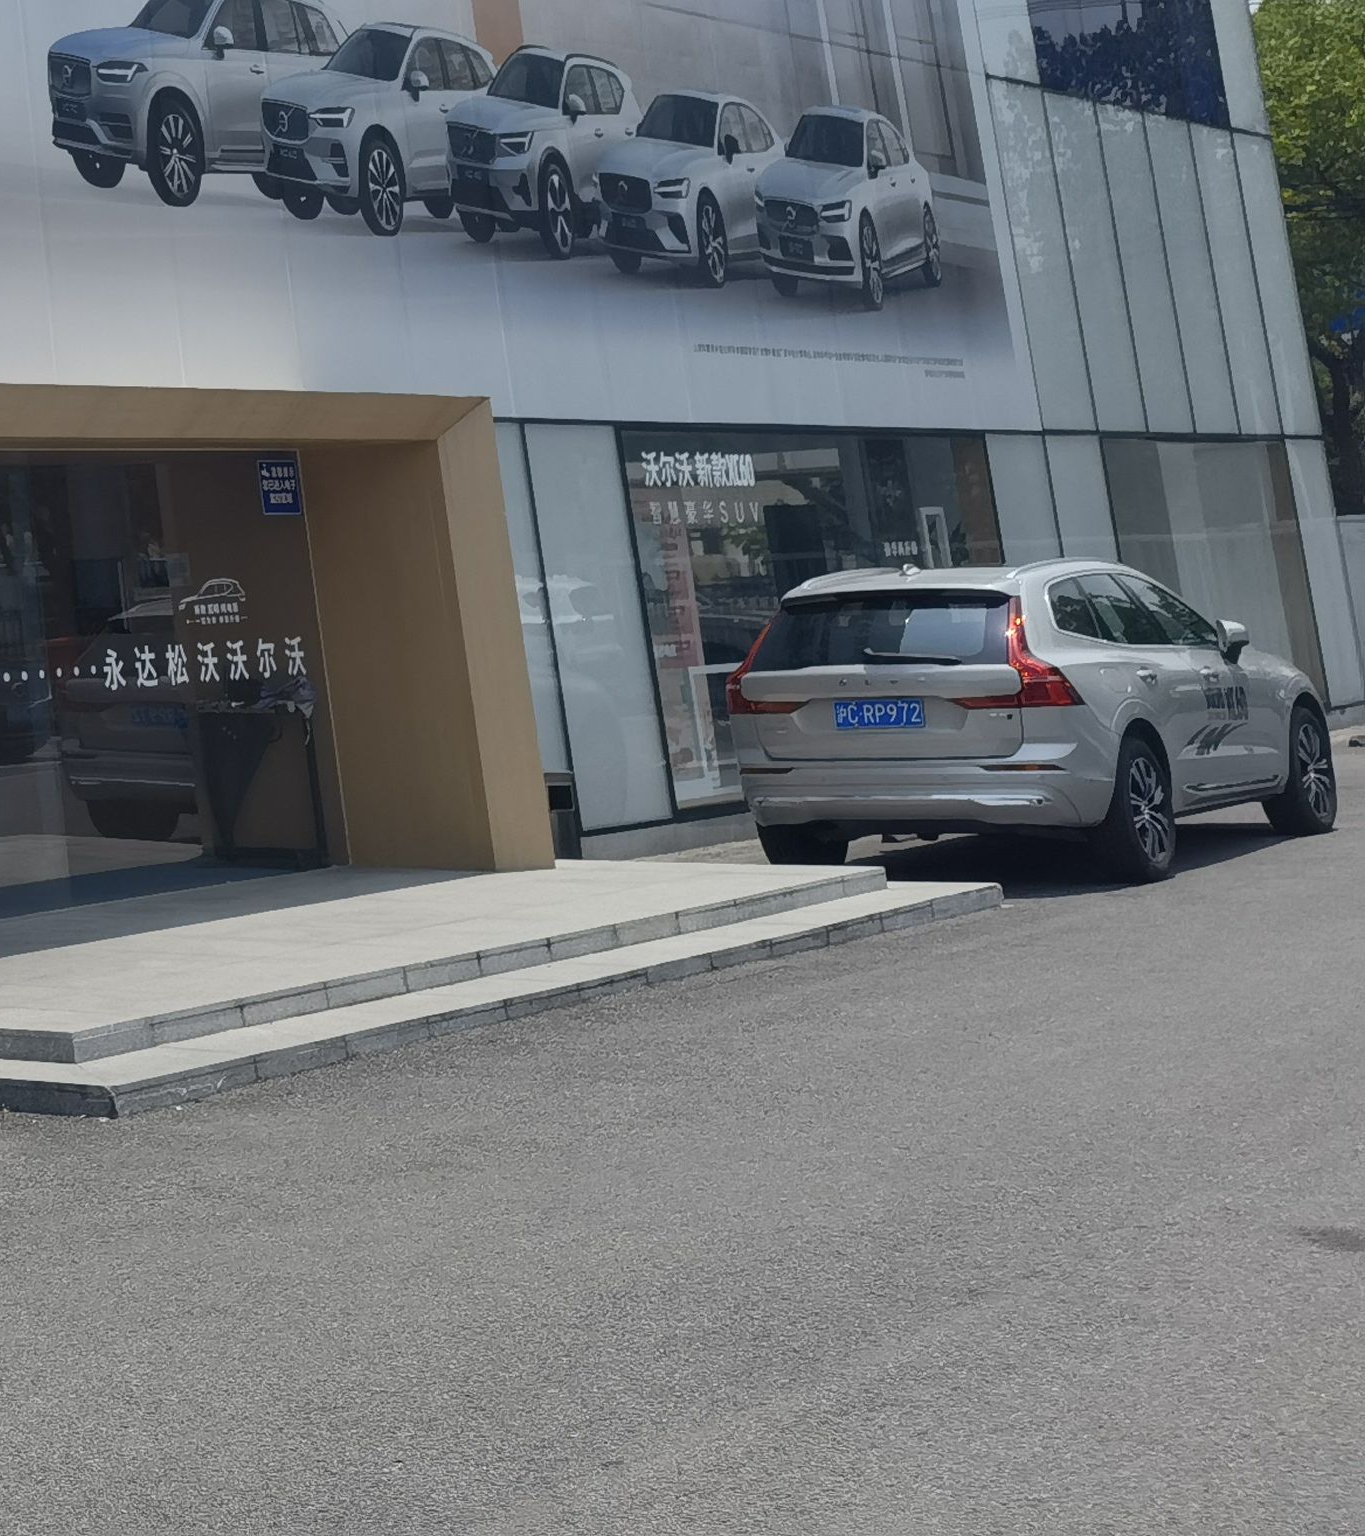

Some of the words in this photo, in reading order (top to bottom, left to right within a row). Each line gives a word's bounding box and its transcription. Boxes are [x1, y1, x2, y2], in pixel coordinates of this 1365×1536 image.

[103, 636, 307, 691] 永达松沃沃尔沃
